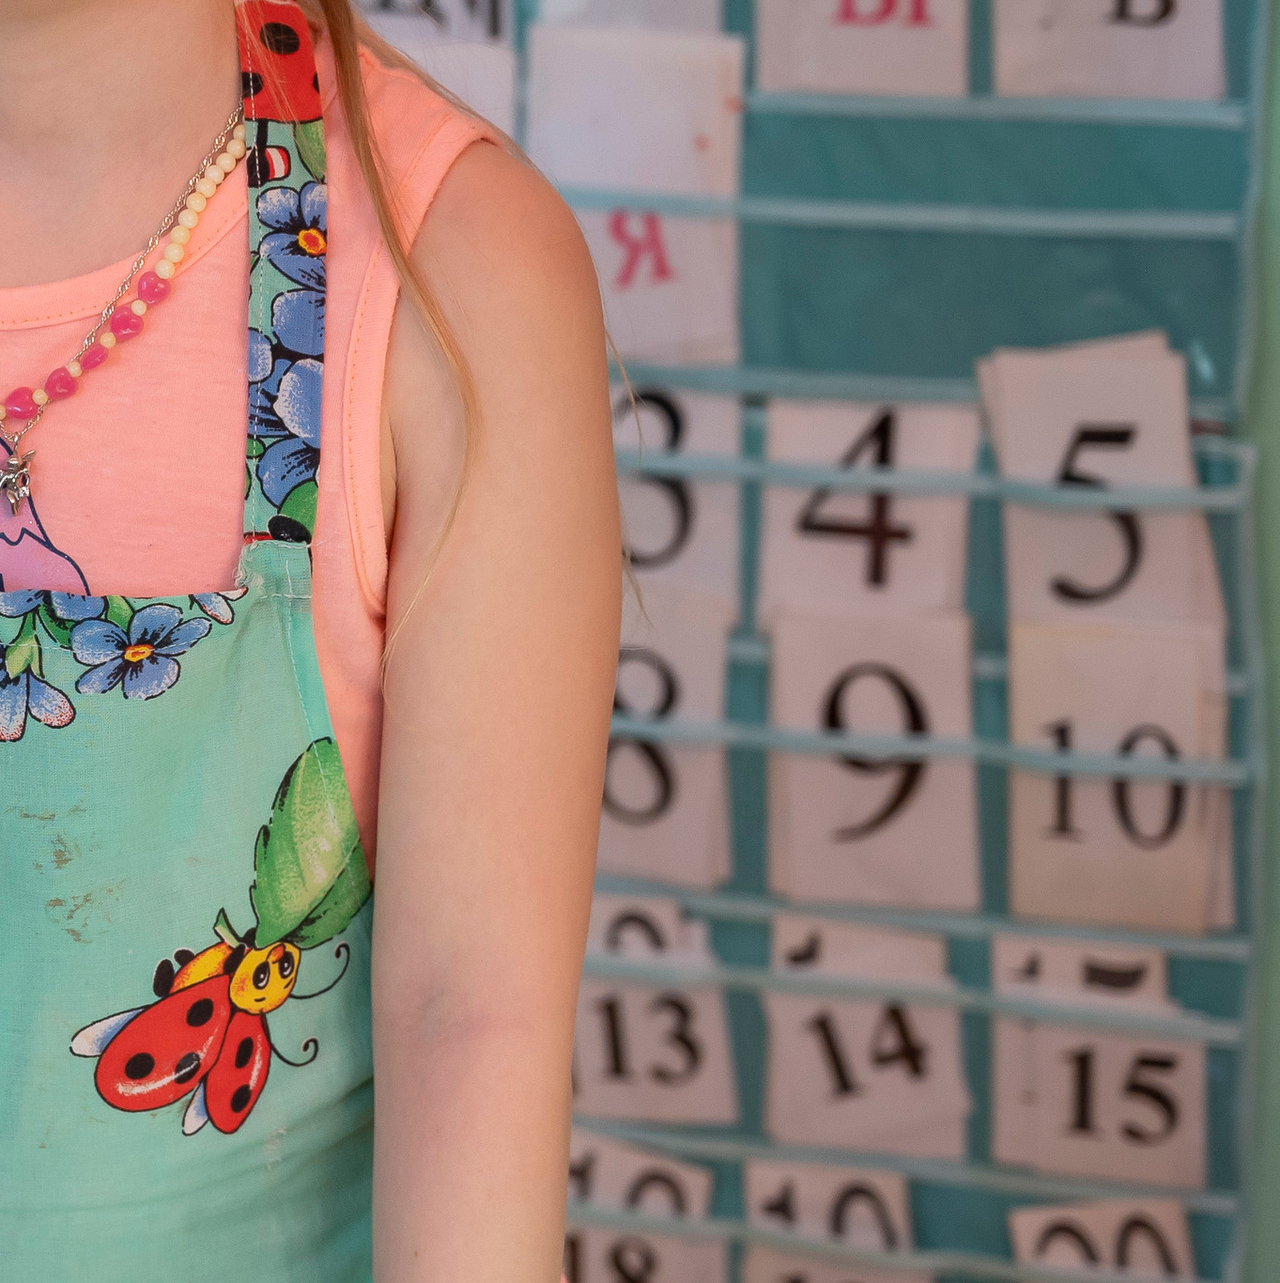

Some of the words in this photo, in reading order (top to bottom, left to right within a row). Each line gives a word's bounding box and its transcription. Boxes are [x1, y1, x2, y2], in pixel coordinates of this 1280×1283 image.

[796, 403, 914, 591] 4
[1046, 421, 1146, 607] 5
[823, 660, 931, 844] 9
[1044, 716, 1188, 851] 10
[597, 990, 706, 1087] 13
[812, 1000, 929, 1102] 14
[1064, 1044, 1184, 1146] 15
